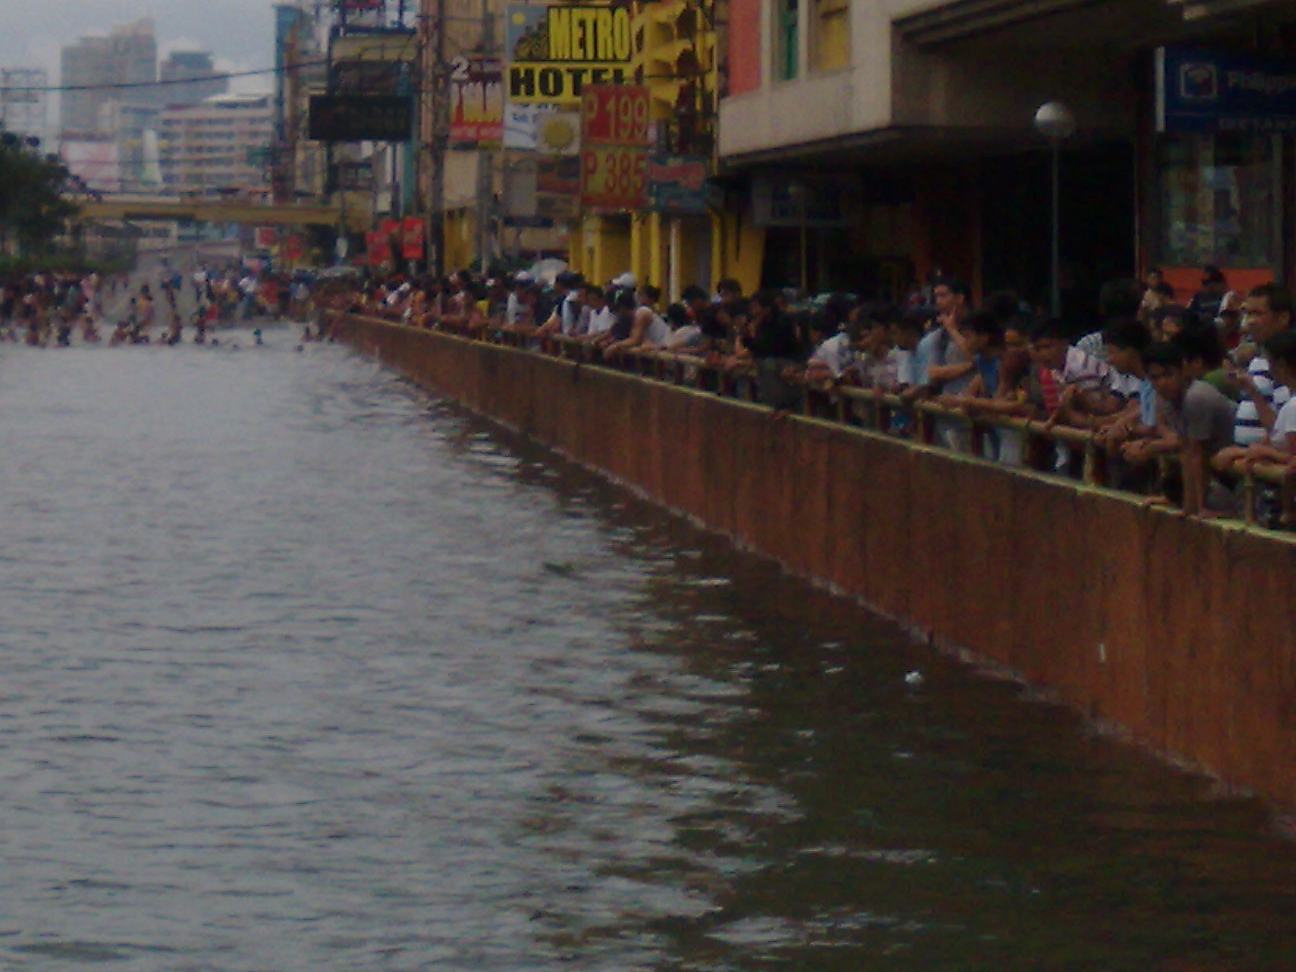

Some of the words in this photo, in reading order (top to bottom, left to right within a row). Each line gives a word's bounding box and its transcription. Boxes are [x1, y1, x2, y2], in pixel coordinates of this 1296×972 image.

[548, 7, 631, 60] METRO
[605, 95, 647, 139] 199
[604, 152, 646, 195] 385
